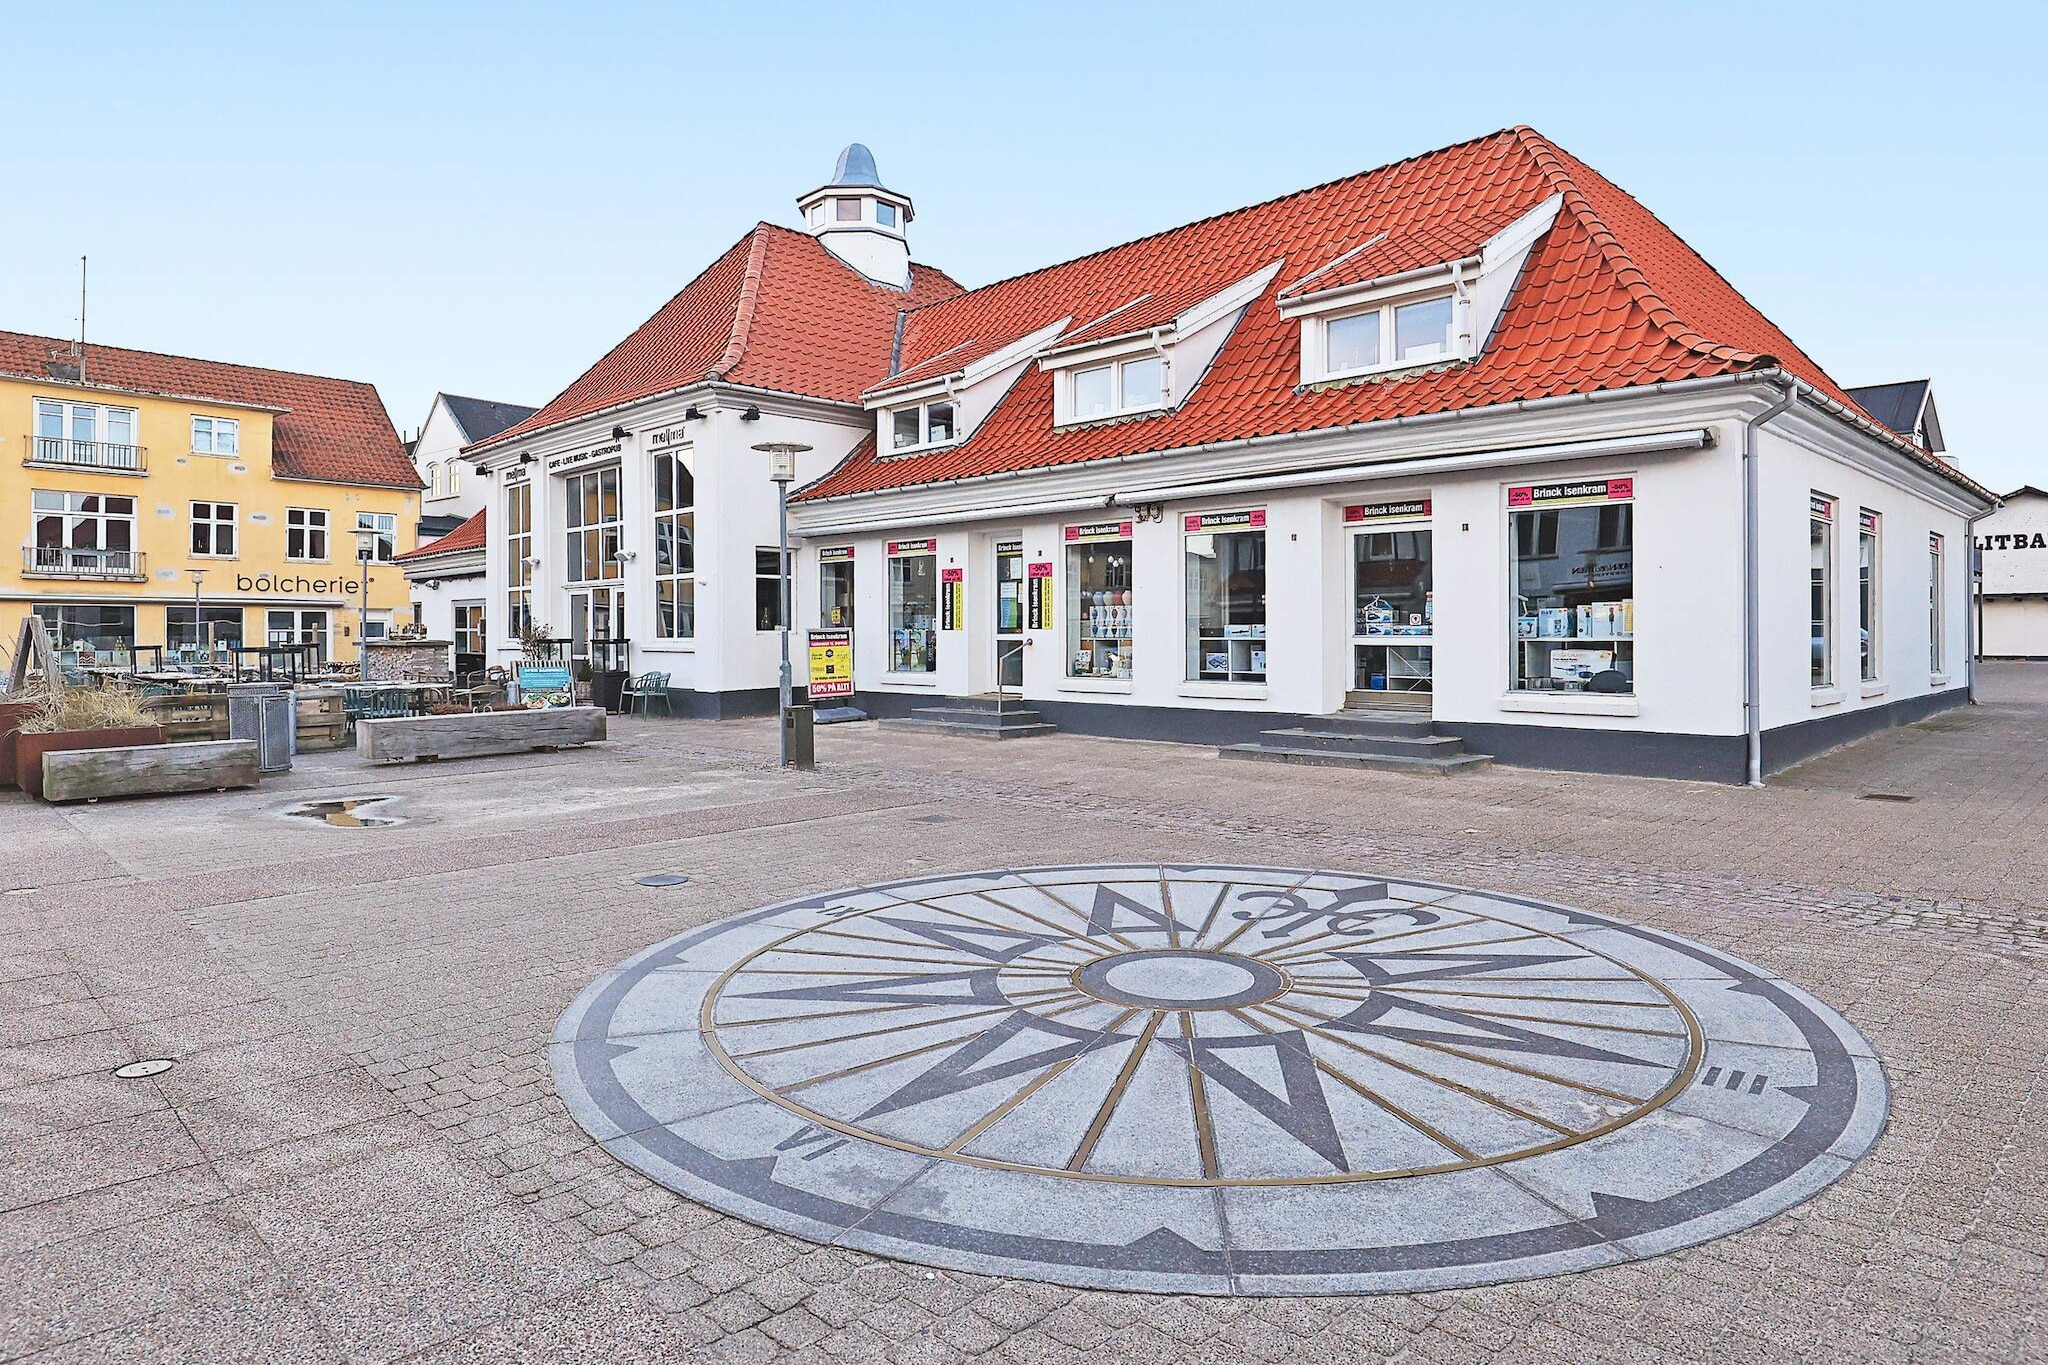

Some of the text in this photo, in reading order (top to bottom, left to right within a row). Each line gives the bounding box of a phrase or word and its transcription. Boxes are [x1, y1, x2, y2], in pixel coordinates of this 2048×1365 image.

[591, 444, 622, 458] GASTROPUB
[1533, 487, 1562, 499] Brinck
[1364, 505, 1388, 516] Brinck
[1201, 516, 1221, 526] Brinck
[1079, 526, 1095, 535] Brinck
[237, 573, 368, 594] bolcherie
[812, 683, 827, 694] 50%
